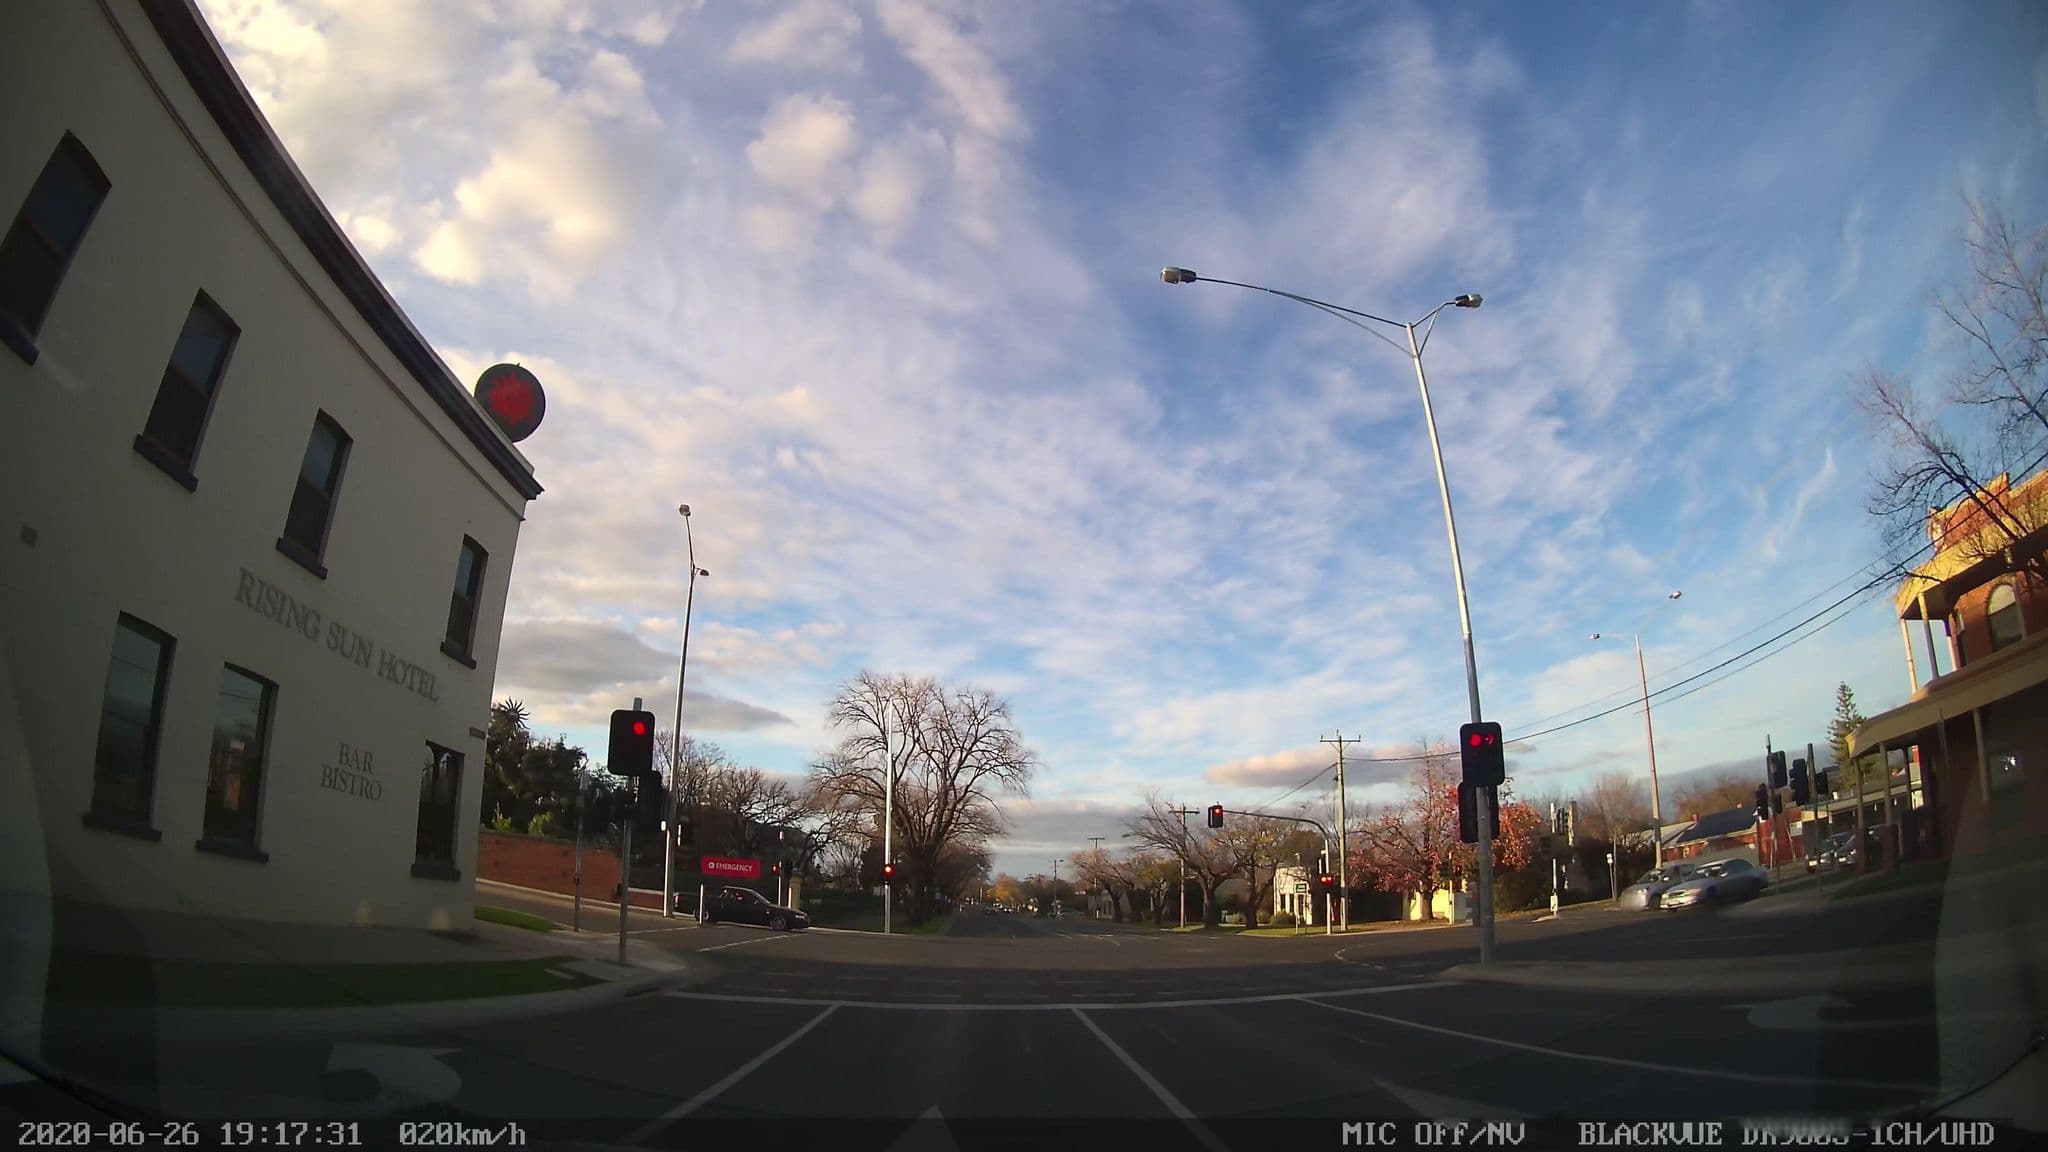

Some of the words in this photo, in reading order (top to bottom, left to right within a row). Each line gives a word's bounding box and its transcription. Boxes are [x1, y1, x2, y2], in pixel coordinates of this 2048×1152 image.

[234, 567, 321, 641] RISING
[327, 621, 373, 669] SUN
[377, 648, 440, 703] HOTEL
[339, 743, 373, 774] BAR
[321, 766, 382, 801] BISTRO
[715, 862, 753, 872] EMERGENCY
